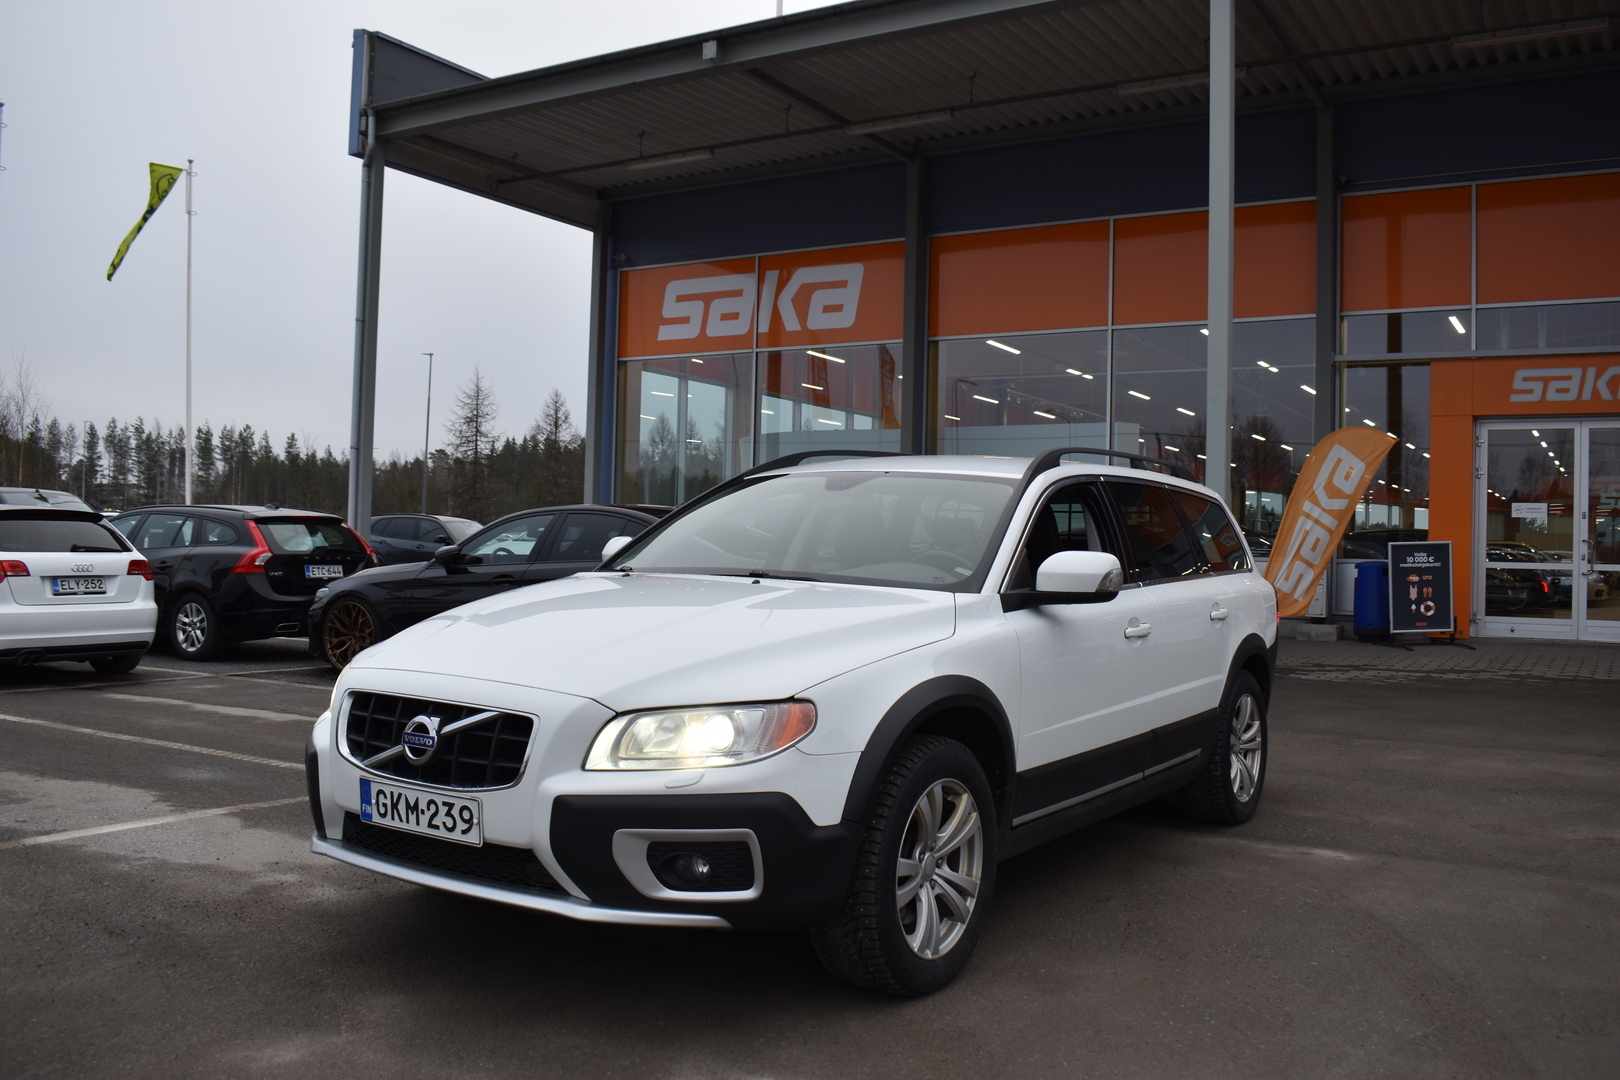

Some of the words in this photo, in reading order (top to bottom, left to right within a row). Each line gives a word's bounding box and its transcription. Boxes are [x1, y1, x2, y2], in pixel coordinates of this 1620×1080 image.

[1509, 366, 1620, 402] sak
[311, 567, 342, 576] ETC-644
[60, 579, 104, 590] ELY-252
[404, 735, 433, 746] VOLVO
[362, 803, 372, 815] FIN
[375, 788, 475, 836] GKM-239
